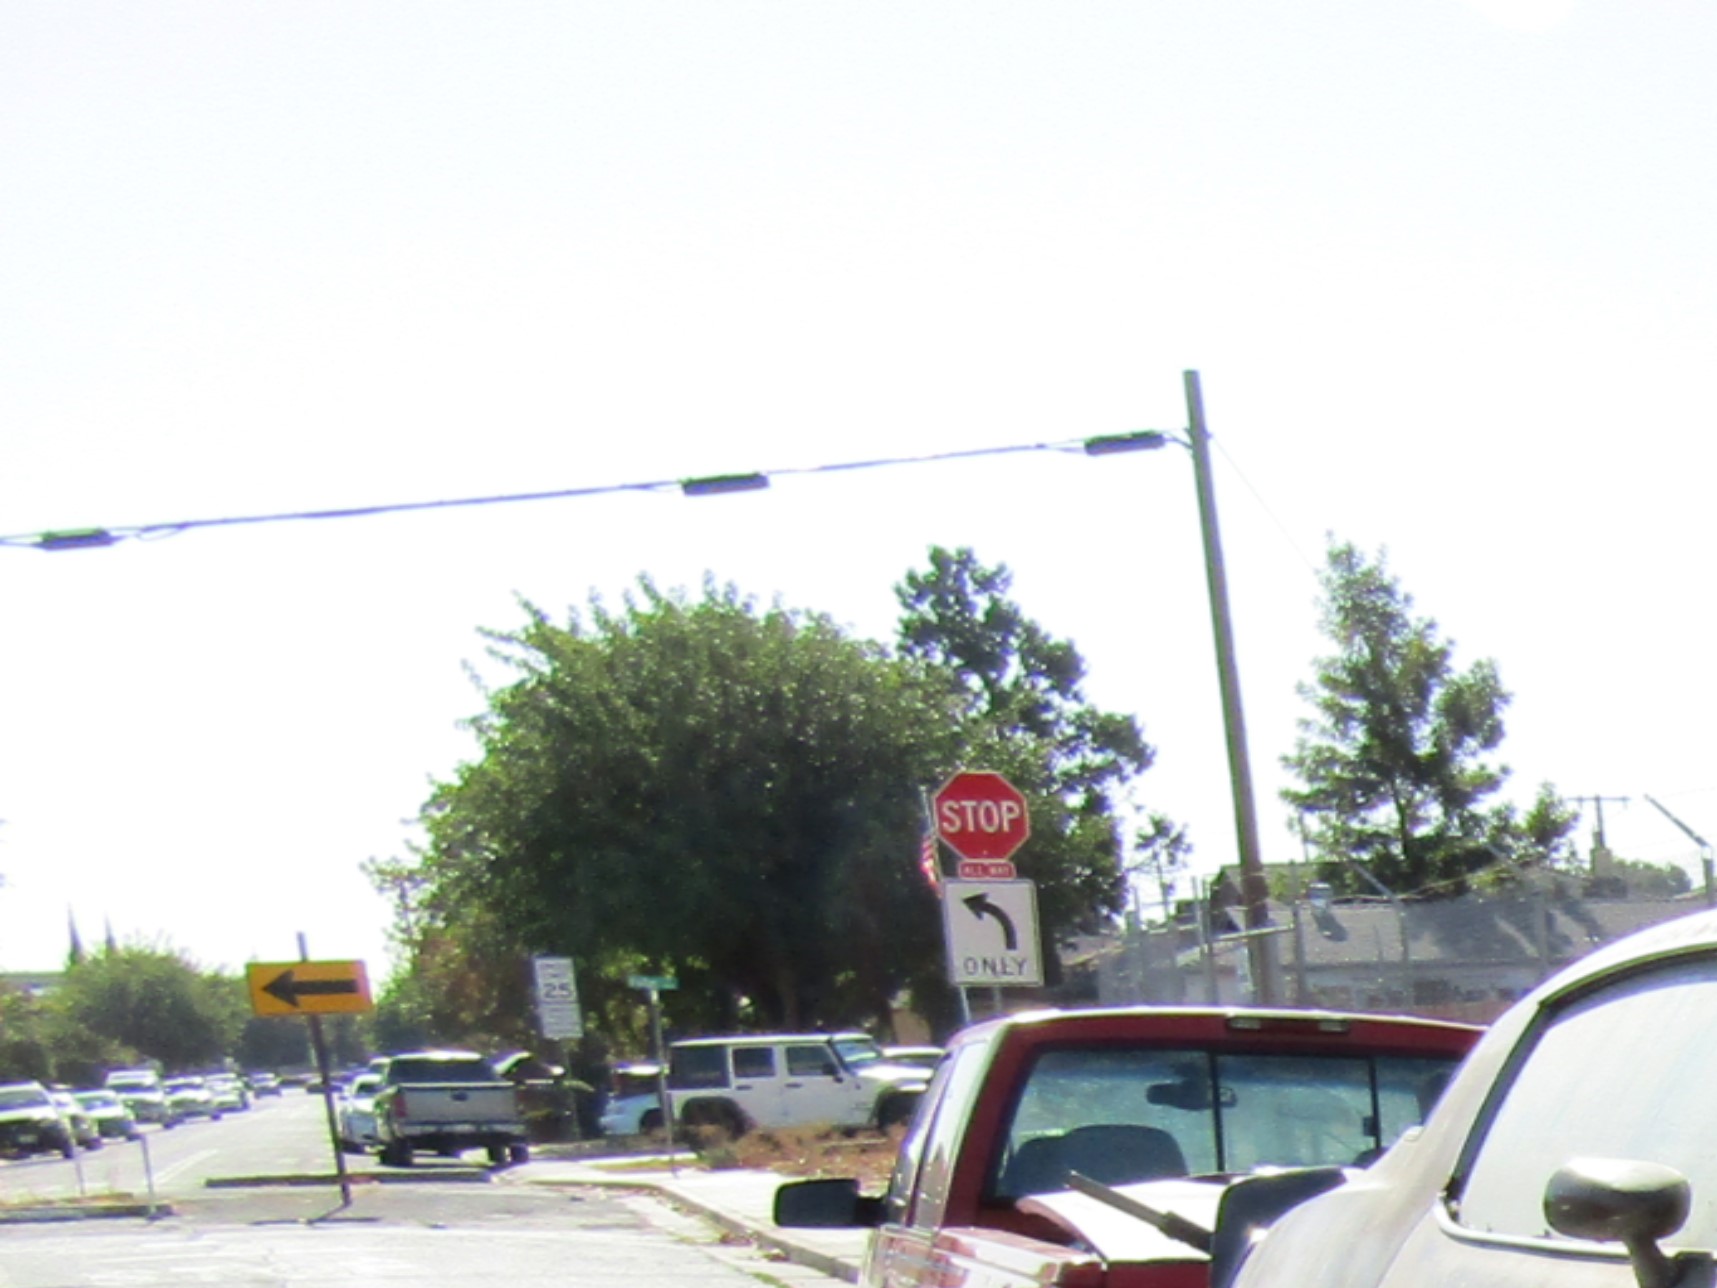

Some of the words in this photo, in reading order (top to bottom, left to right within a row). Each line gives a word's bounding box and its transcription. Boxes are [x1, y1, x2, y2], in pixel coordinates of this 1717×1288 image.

[942, 799, 1020, 833] STOP
[963, 957, 1028, 976] ONLY
[543, 982, 572, 999] 25
